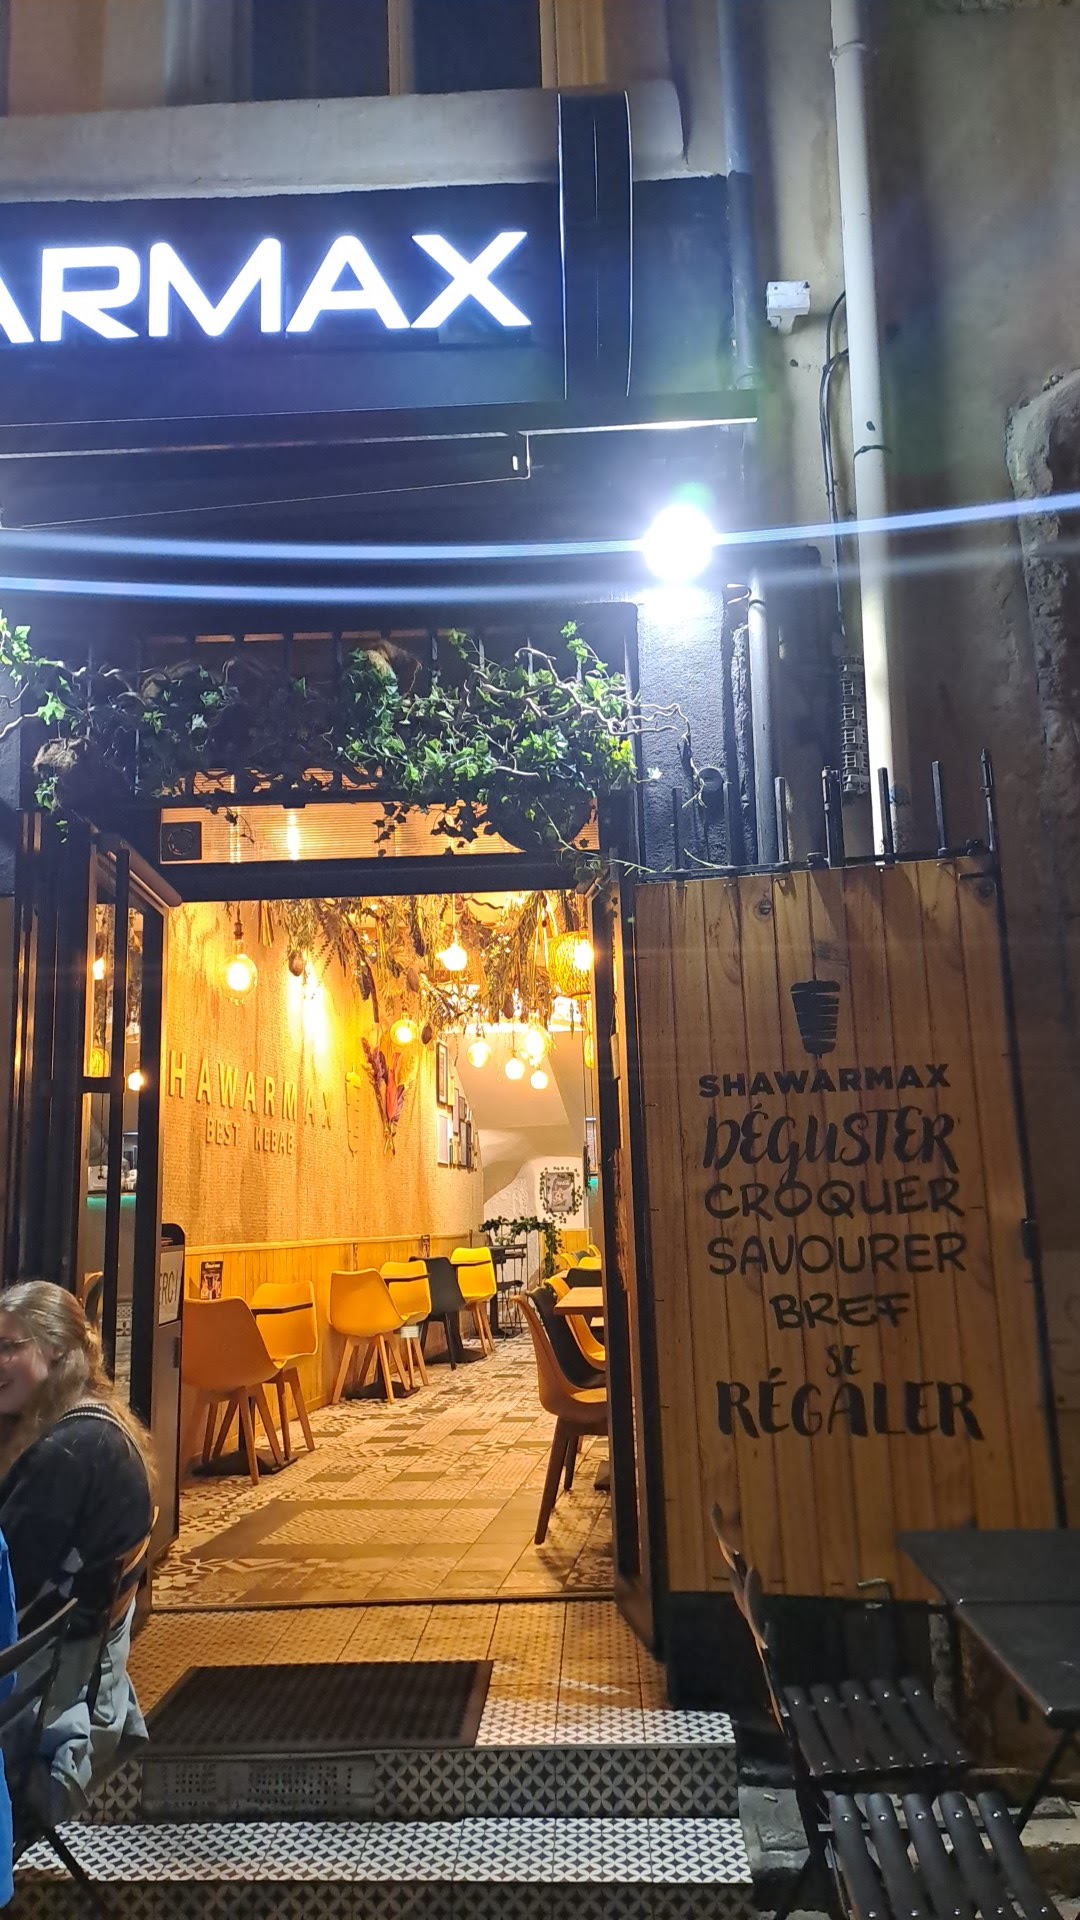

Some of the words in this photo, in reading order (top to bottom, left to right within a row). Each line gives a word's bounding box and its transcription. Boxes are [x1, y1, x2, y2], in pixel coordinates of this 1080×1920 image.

[0, 231, 532, 343] RMAX
[699, 1063, 951, 1098] SHAWARMAX
[205, 1117, 240, 1147] BEST
[254, 1126, 295, 1155] KEBAB
[704, 1175, 966, 1222] CROQUER
[707, 1232, 966, 1275] SAVOURER
[769, 1292, 910, 1330] BREF
[825, 1344, 862, 1376] SE
[716, 1367, 985, 1441] RÉGALER
